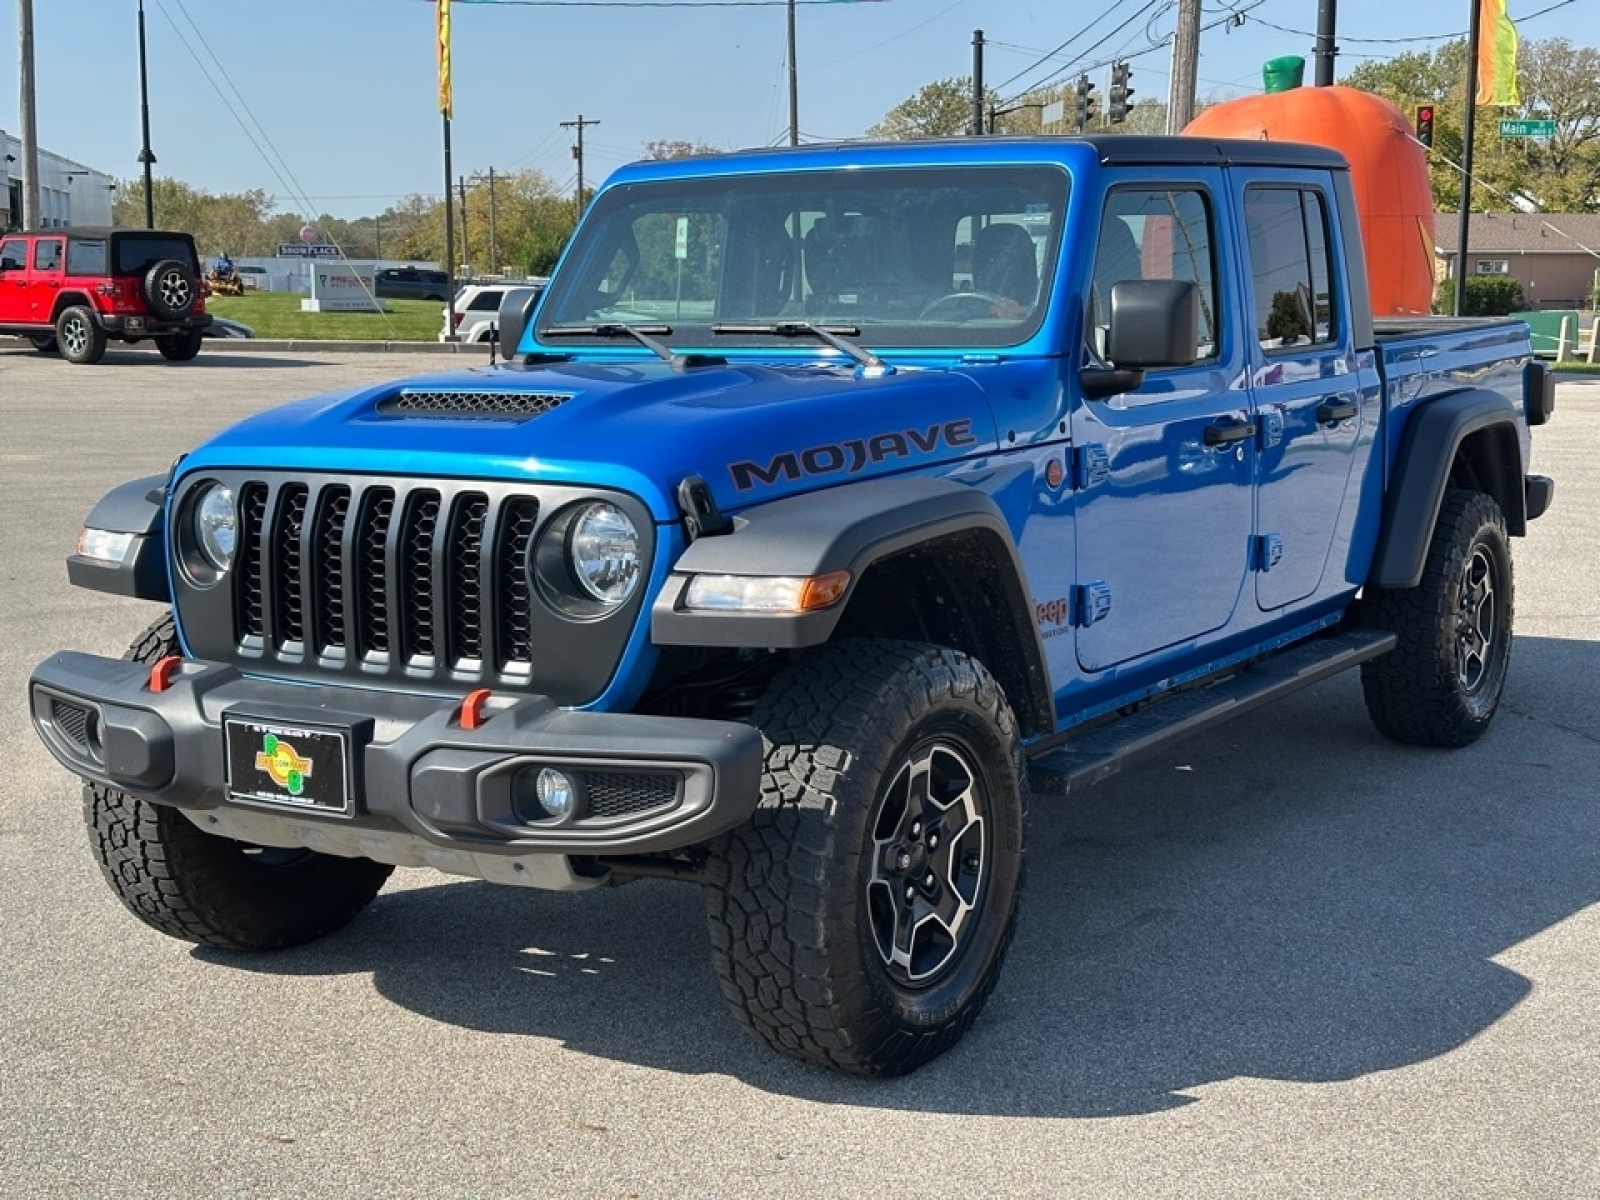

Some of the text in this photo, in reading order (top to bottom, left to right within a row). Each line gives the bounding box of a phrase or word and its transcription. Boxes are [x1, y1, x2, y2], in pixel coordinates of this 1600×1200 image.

[1501, 122, 1526, 134] Main
[728, 419, 976, 490] MOJAVE
[1036, 597, 1067, 625] eep
